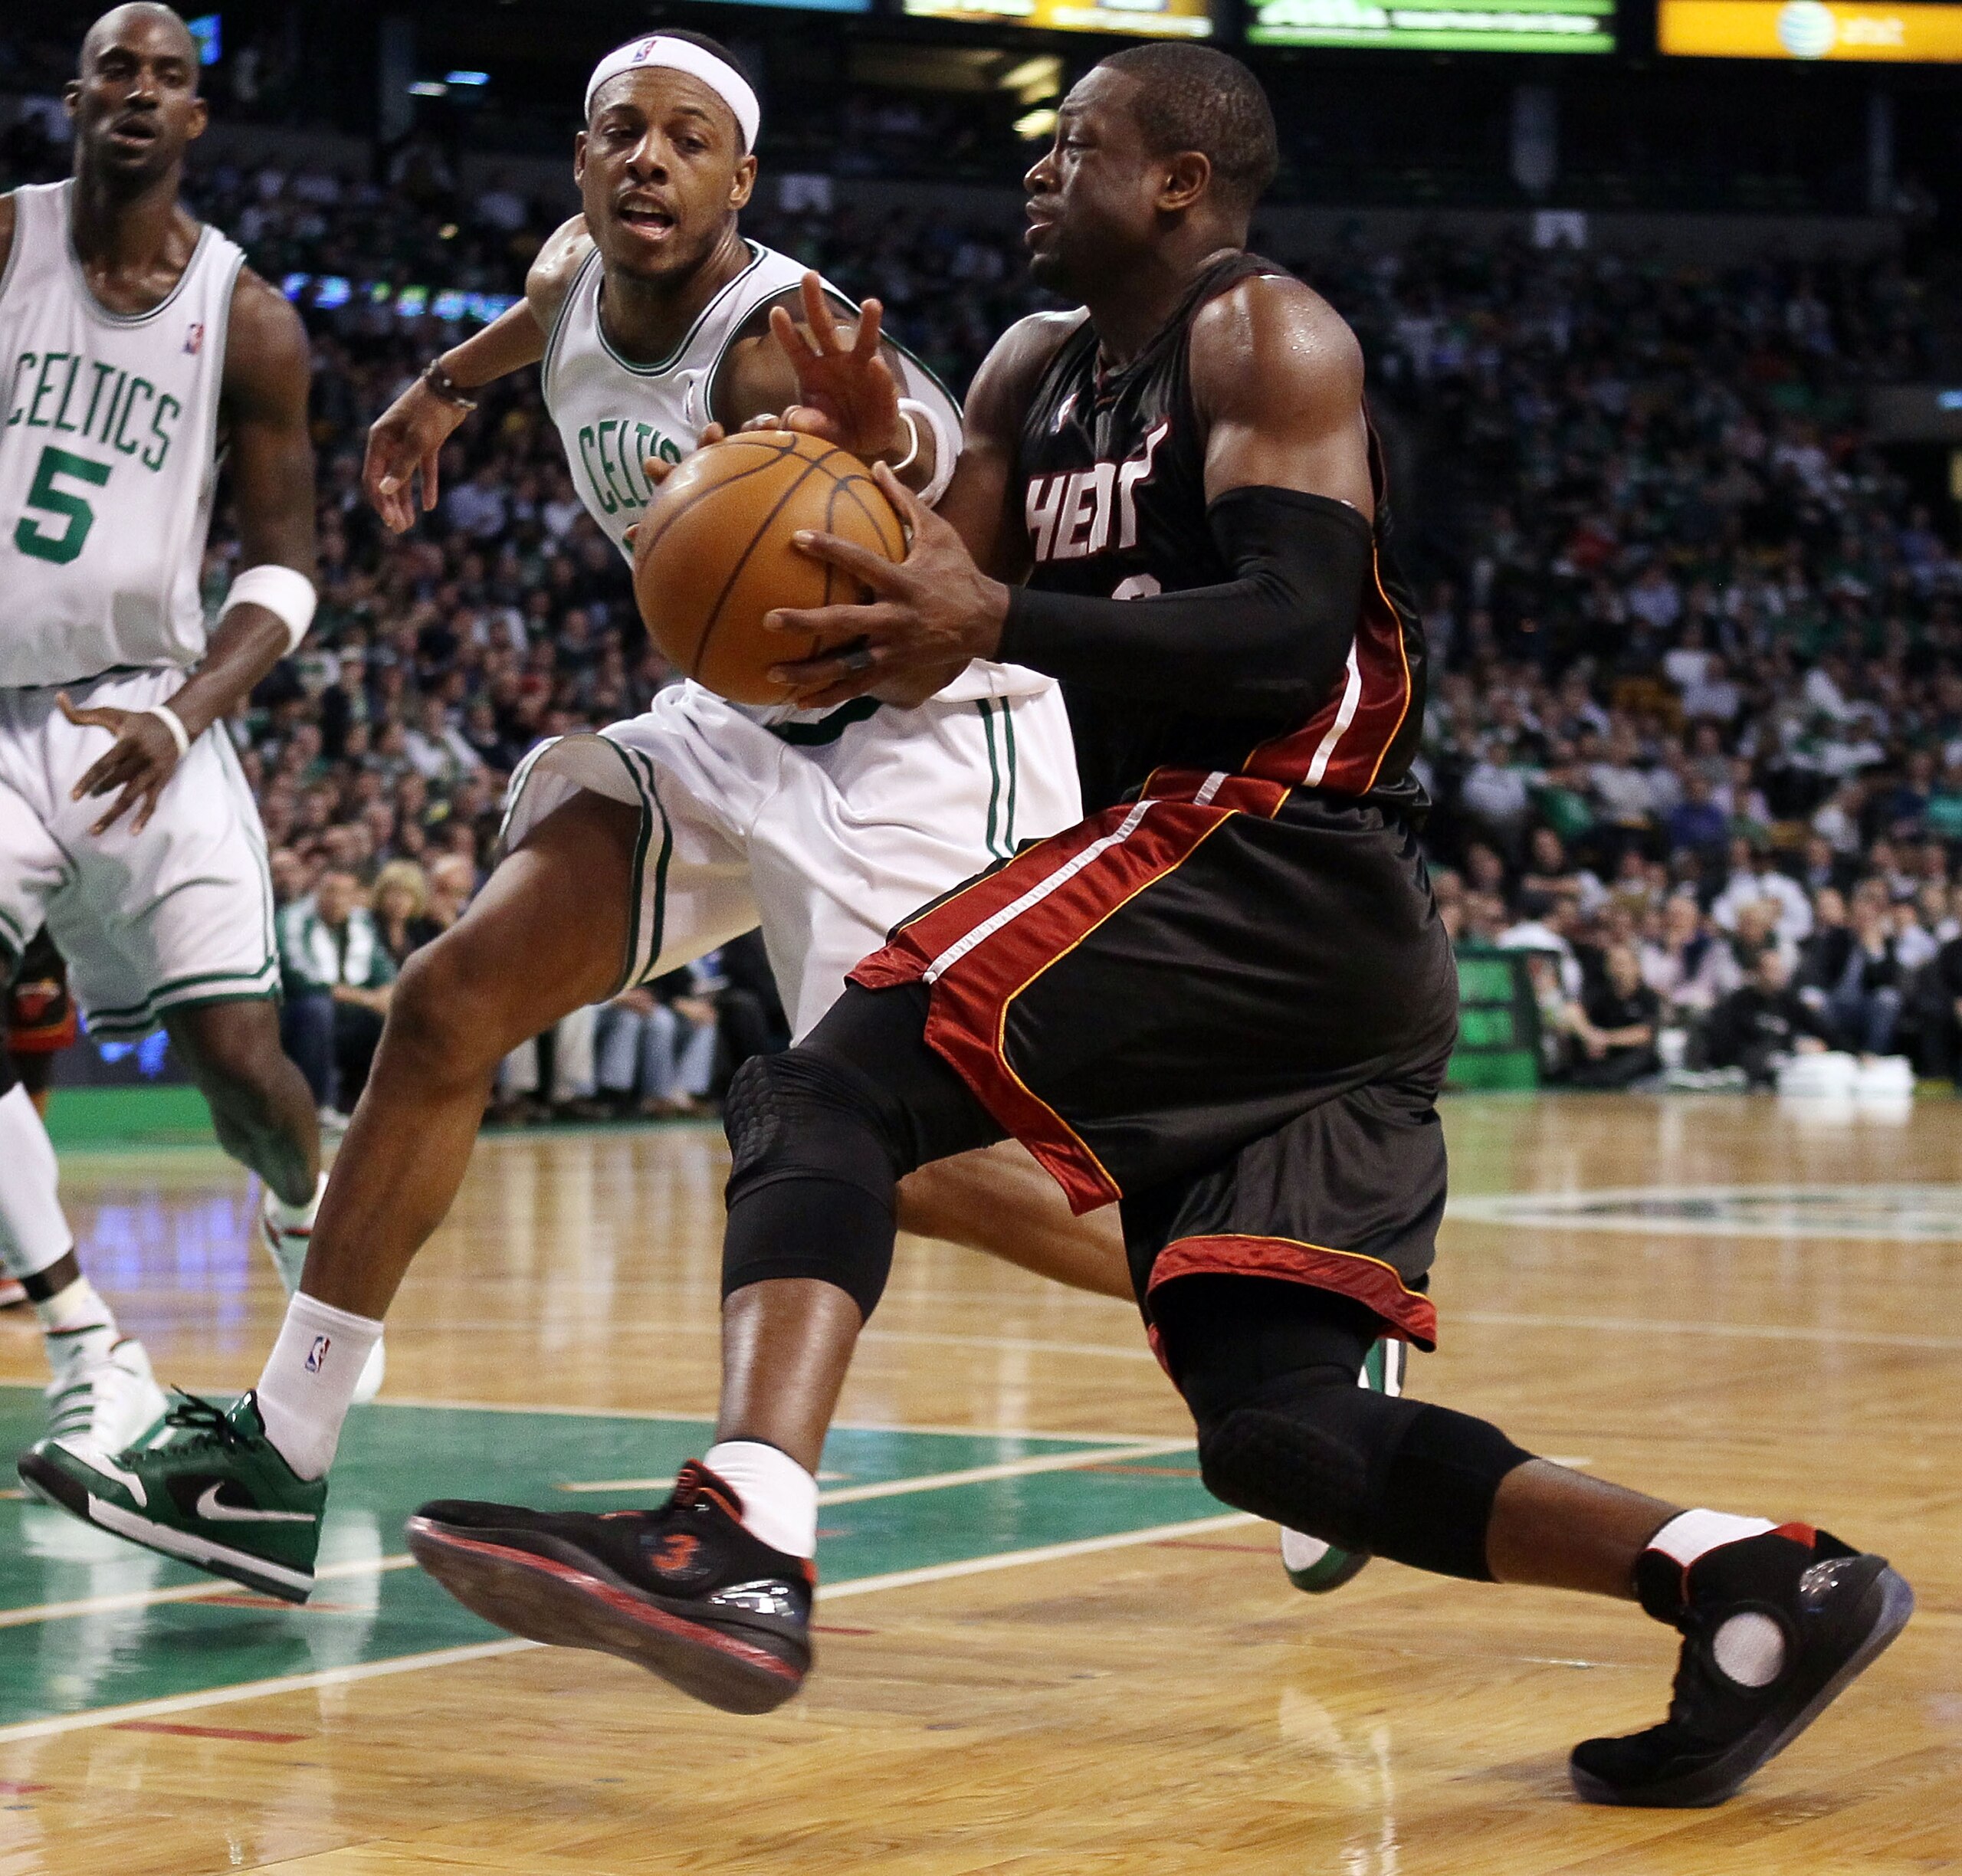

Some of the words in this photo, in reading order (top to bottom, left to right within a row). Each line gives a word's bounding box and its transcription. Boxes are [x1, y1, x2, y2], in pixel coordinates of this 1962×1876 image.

[6, 352, 182, 473] CELTICS
[13, 445, 113, 566] 5
[1025, 421, 1169, 562] HEAT
